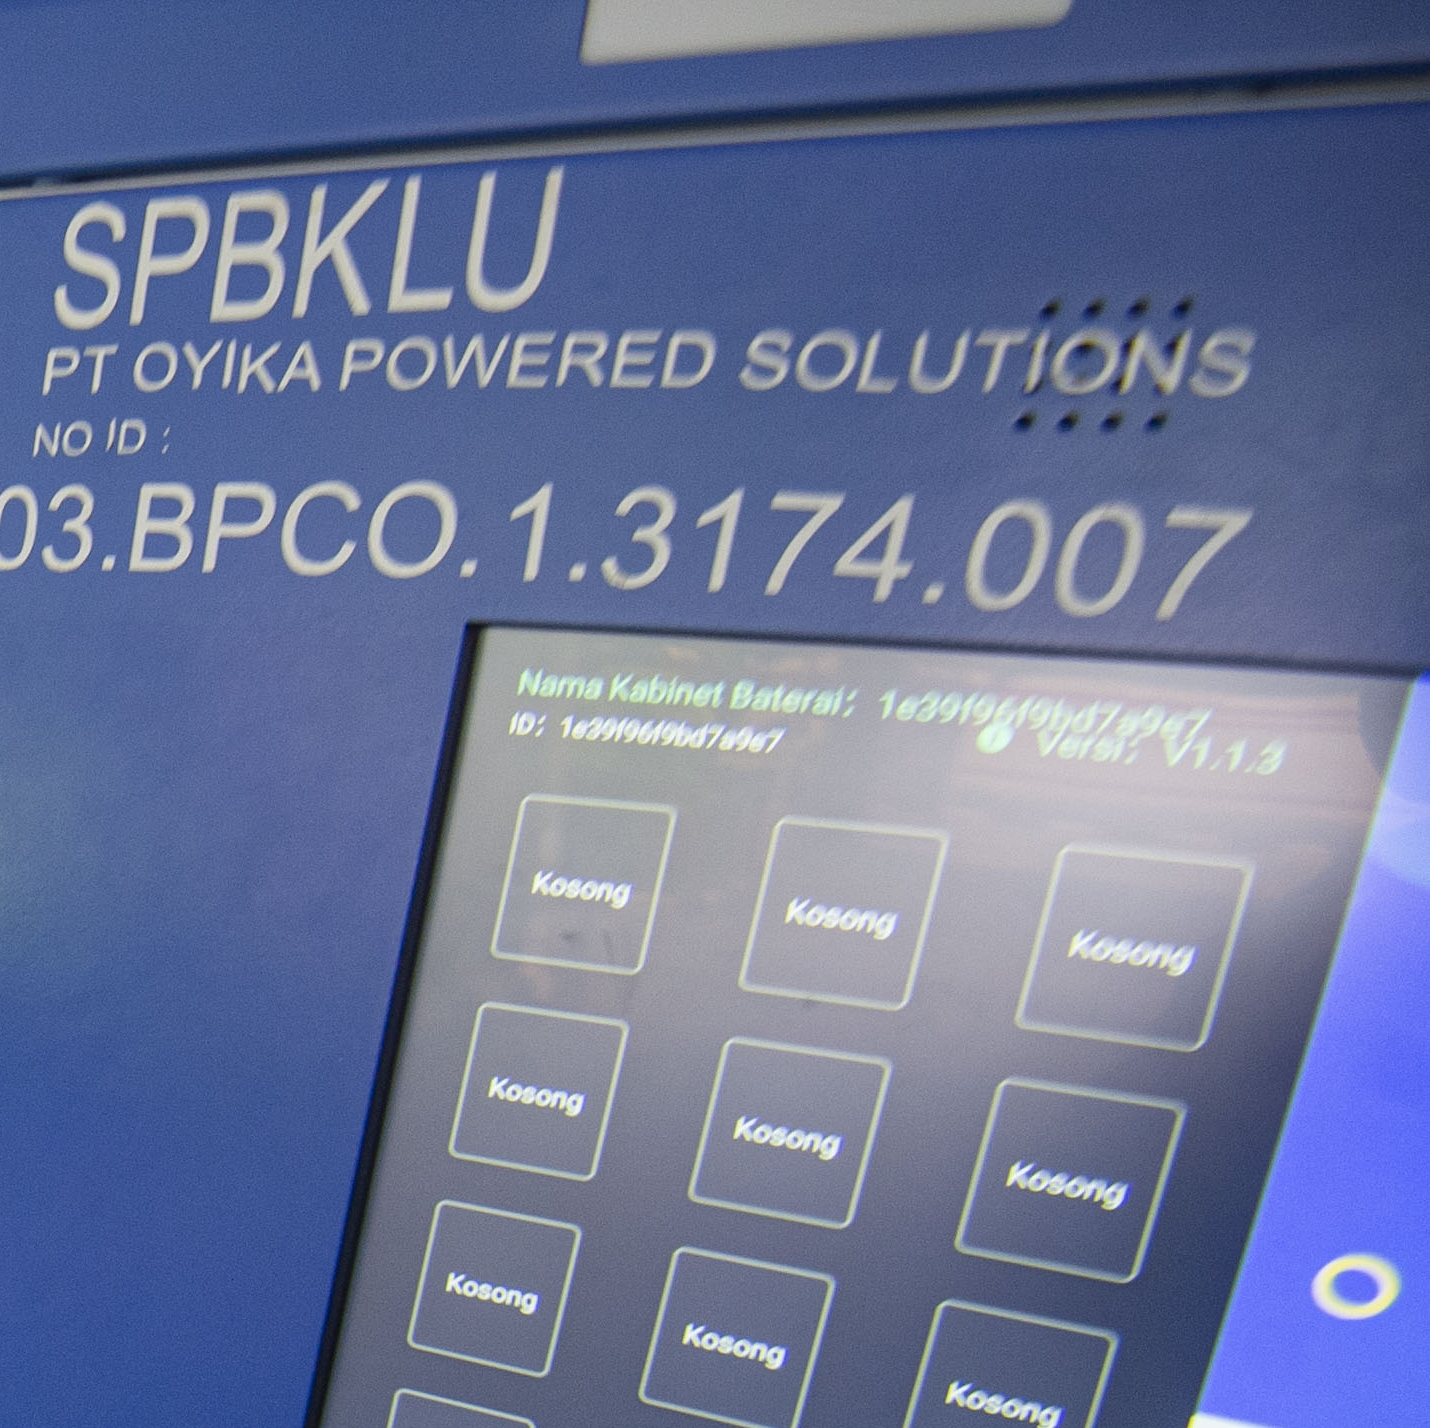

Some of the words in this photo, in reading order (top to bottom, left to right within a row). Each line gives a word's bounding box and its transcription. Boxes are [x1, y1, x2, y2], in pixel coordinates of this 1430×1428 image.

[53, 164, 565, 331] SPBKLU
[41, 343, 119, 396] PT
[132, 337, 322, 395] OYIKA
[338, 330, 718, 392] POWERED
[738, 327, 1258, 399] SOLUTIONS
[32, 420, 93, 458] NO
[104, 417, 148, 456] ID
[516, 668, 605, 701] Nama
[608, 672, 727, 709] Kabinet
[729, 678, 860, 719] Baterai:
[508, 710, 547, 738] ID:
[1163, 733, 1290, 776] V1.1.3
[531, 871, 632, 909] Kosong
[785, 898, 898, 941] Kosong
[1068, 930, 1195, 977] Kosong
[488, 1076, 585, 1118] Kosong
[733, 1116, 842, 1161] Kosong
[1006, 1160, 1130, 1211] Kosong
[445, 1271, 539, 1315] Kosong
[682, 1323, 787, 1370] Kosong
